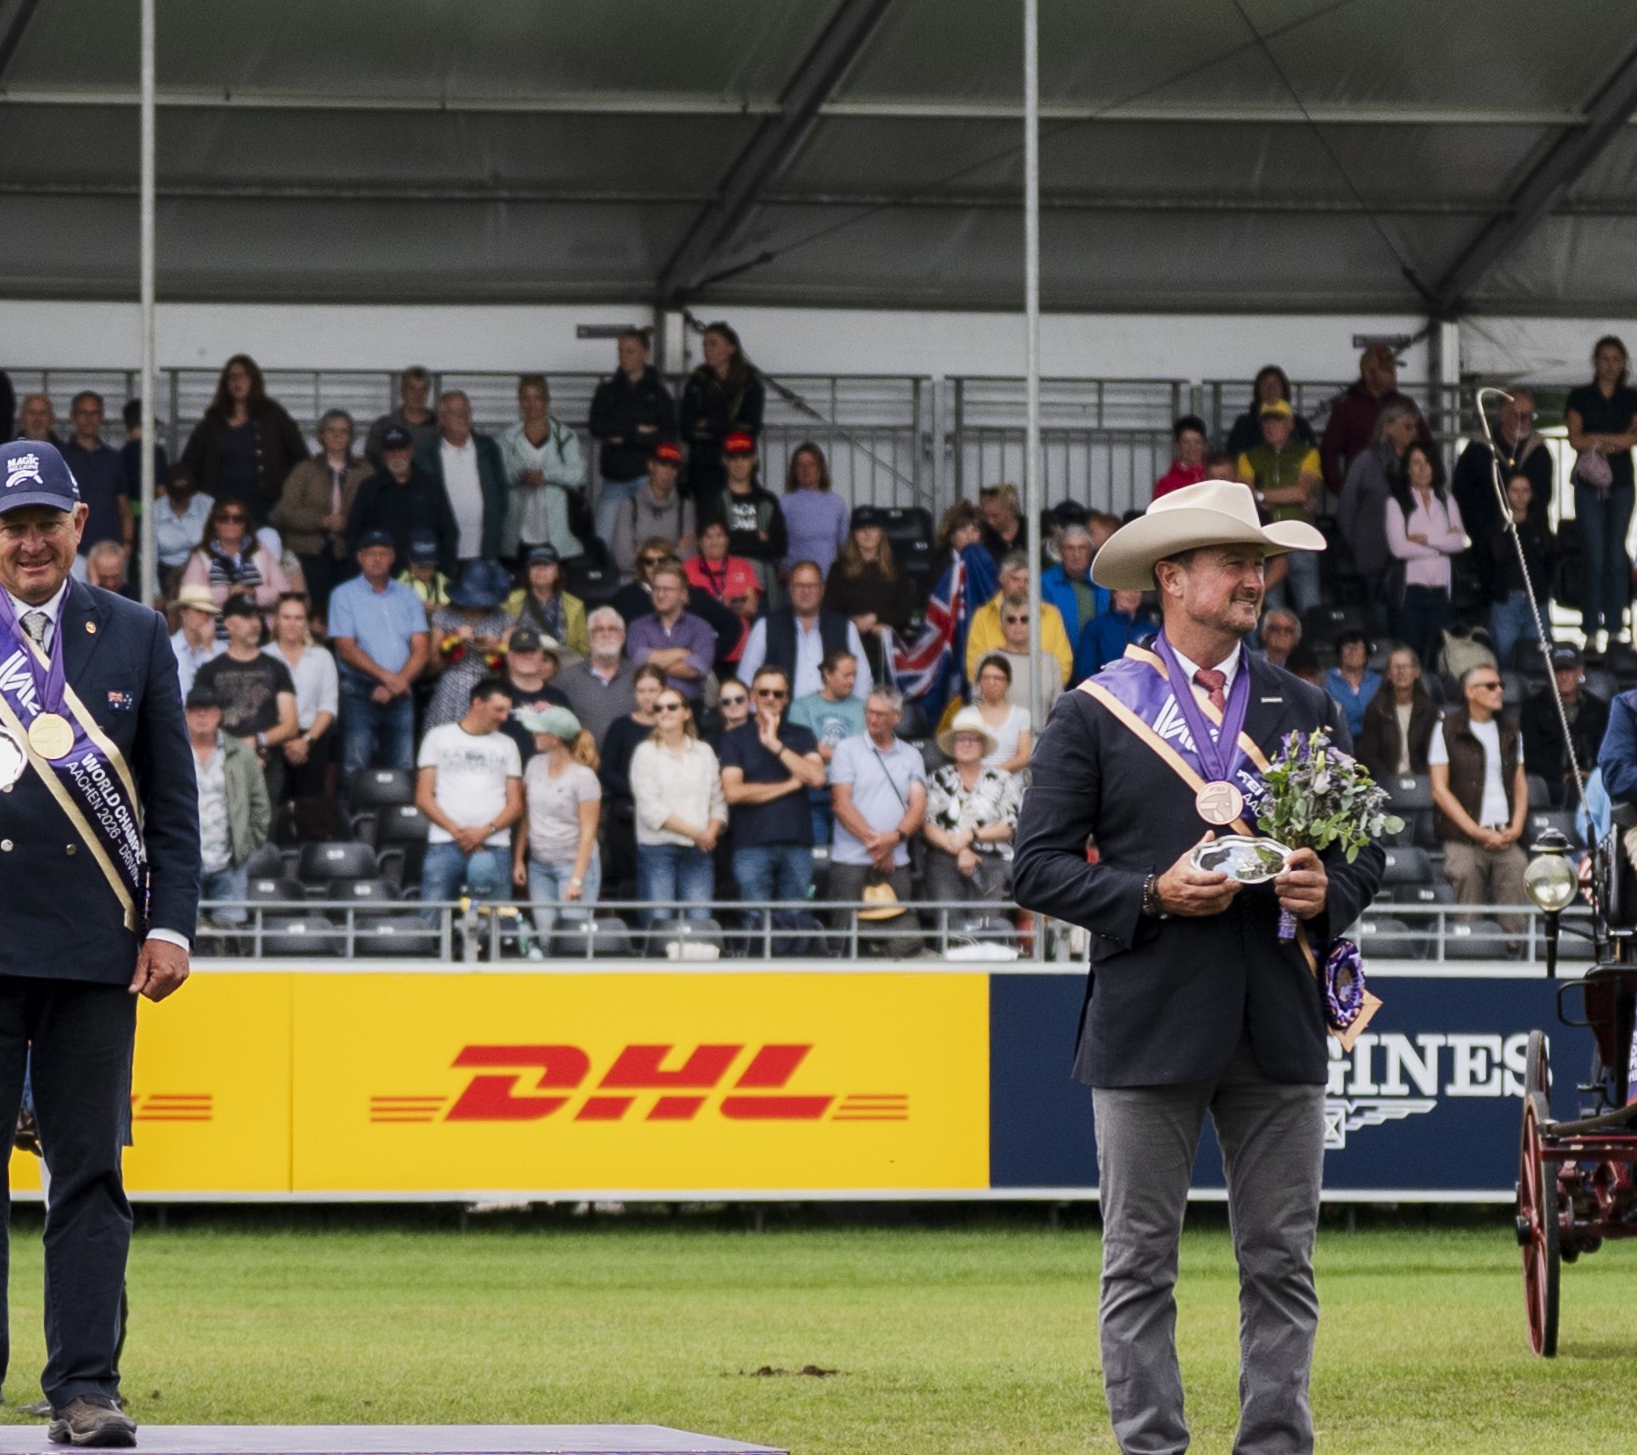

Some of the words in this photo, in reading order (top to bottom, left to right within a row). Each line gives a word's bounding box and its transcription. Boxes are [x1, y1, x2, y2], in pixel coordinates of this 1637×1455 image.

[7, 454, 39, 466] MAGIC
[65, 761, 104, 811] AACHEN
[96, 807, 121, 839] 2026
[81, 752, 121, 808] WORLD
[1236, 769, 1264, 796] FEI
[444, 1043, 836, 1123] DHL
